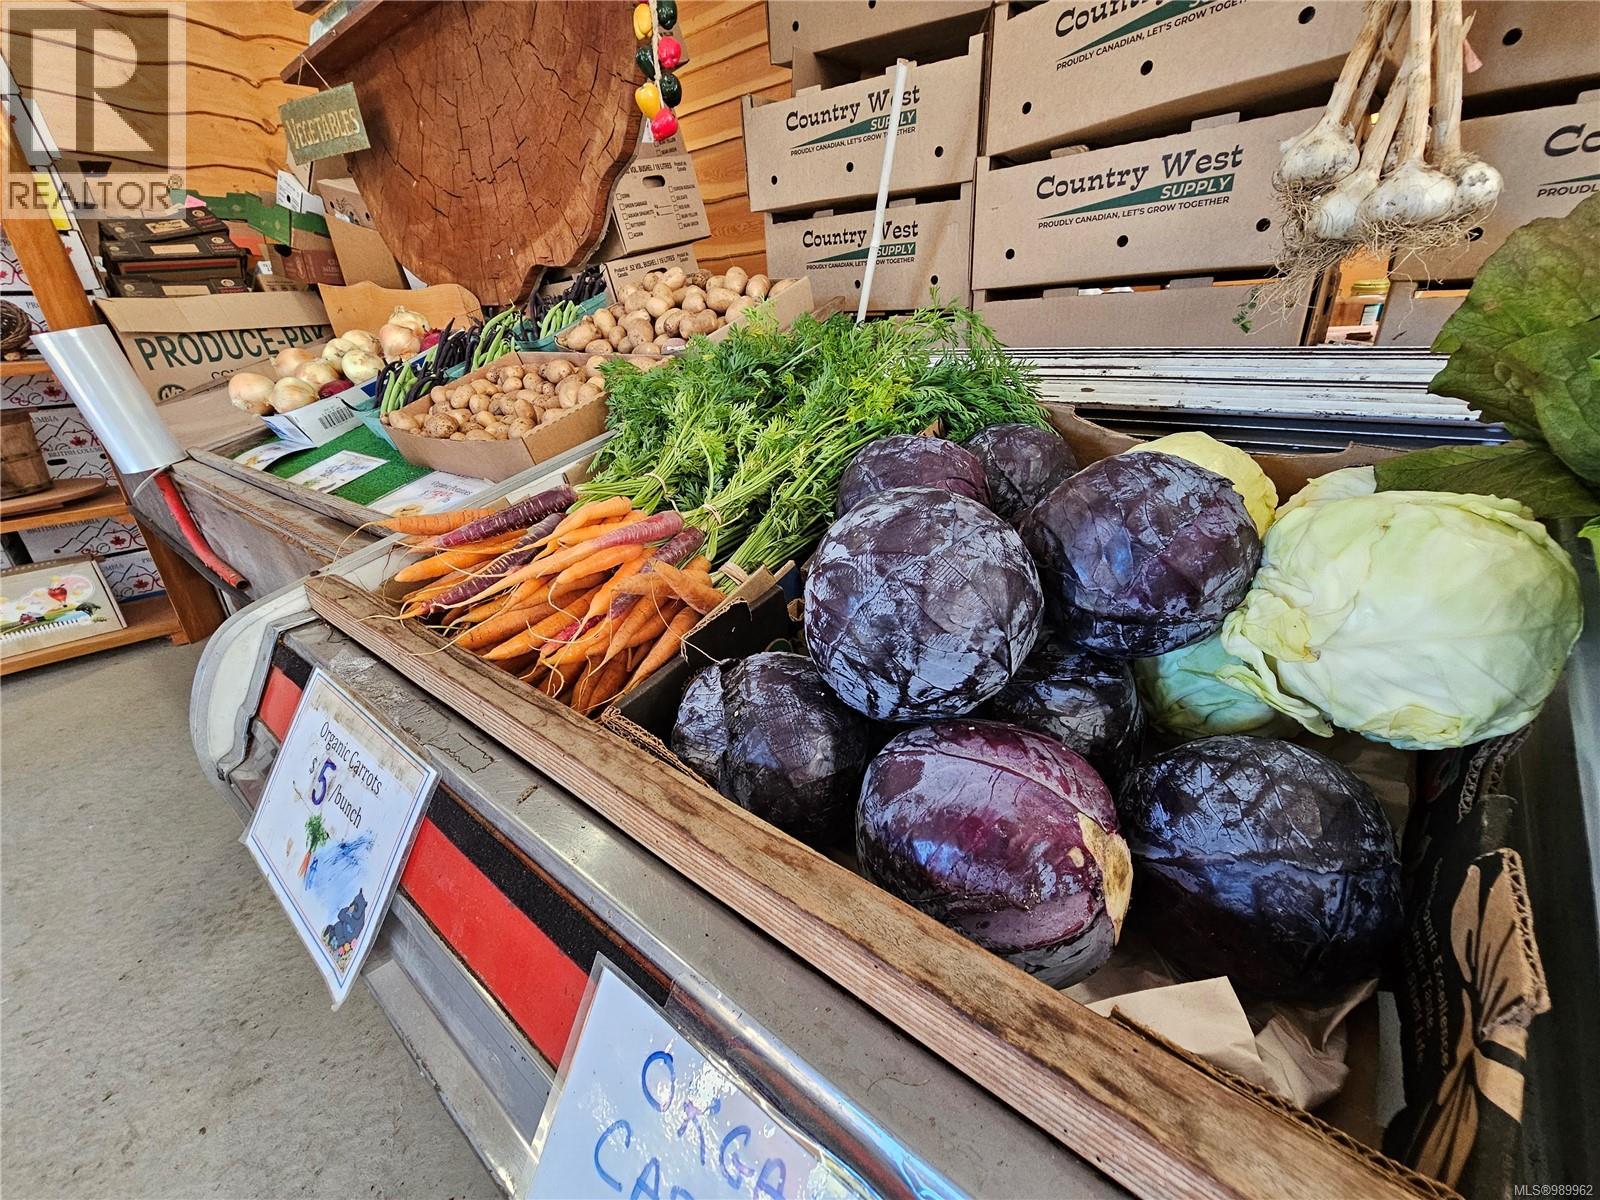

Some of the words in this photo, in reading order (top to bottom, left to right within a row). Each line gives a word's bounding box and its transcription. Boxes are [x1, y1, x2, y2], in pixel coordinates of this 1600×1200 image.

[1056, 0, 1164, 37] Coun
[1056, 52, 1095, 71] PROUDLY
[1095, 33, 1145, 56] CANADIAN,
[1146, 22, 1172, 38] LET'S
[1174, 9, 1206, 28] GROW
[285, 108, 360, 150] VEGETABLES
[786, 102, 861, 131] Country
[870, 111, 915, 131] SUPLY
[790, 146, 815, 156] PROUDLY
[815, 140, 847, 152] CANADIAN,
[847, 136, 863, 146] LET'S
[863, 133, 881, 142] GROW
[1036, 163, 1149, 199] Country
[1161, 144, 1244, 179] West
[1160, 177, 1232, 199] SUPPLY
[1038, 216, 1074, 230] PROUDLY
[1075, 211, 1120, 225] CANADIAN,
[1122, 207, 1145, 218] LET'S
[1147, 202, 1176, 214] GROW
[1178, 195, 1230, 210] TOGETHER
[802, 228, 867, 248] Country
[806, 262, 828, 270] PROUDLY
[828, 261, 855, 269] CANADIAN,
[886, 256, 915, 265] TOGETHER
[320, 721, 351, 762] Organic
[348, 751, 383, 796] Carrots
[594, 1119, 696, 1200] CA
